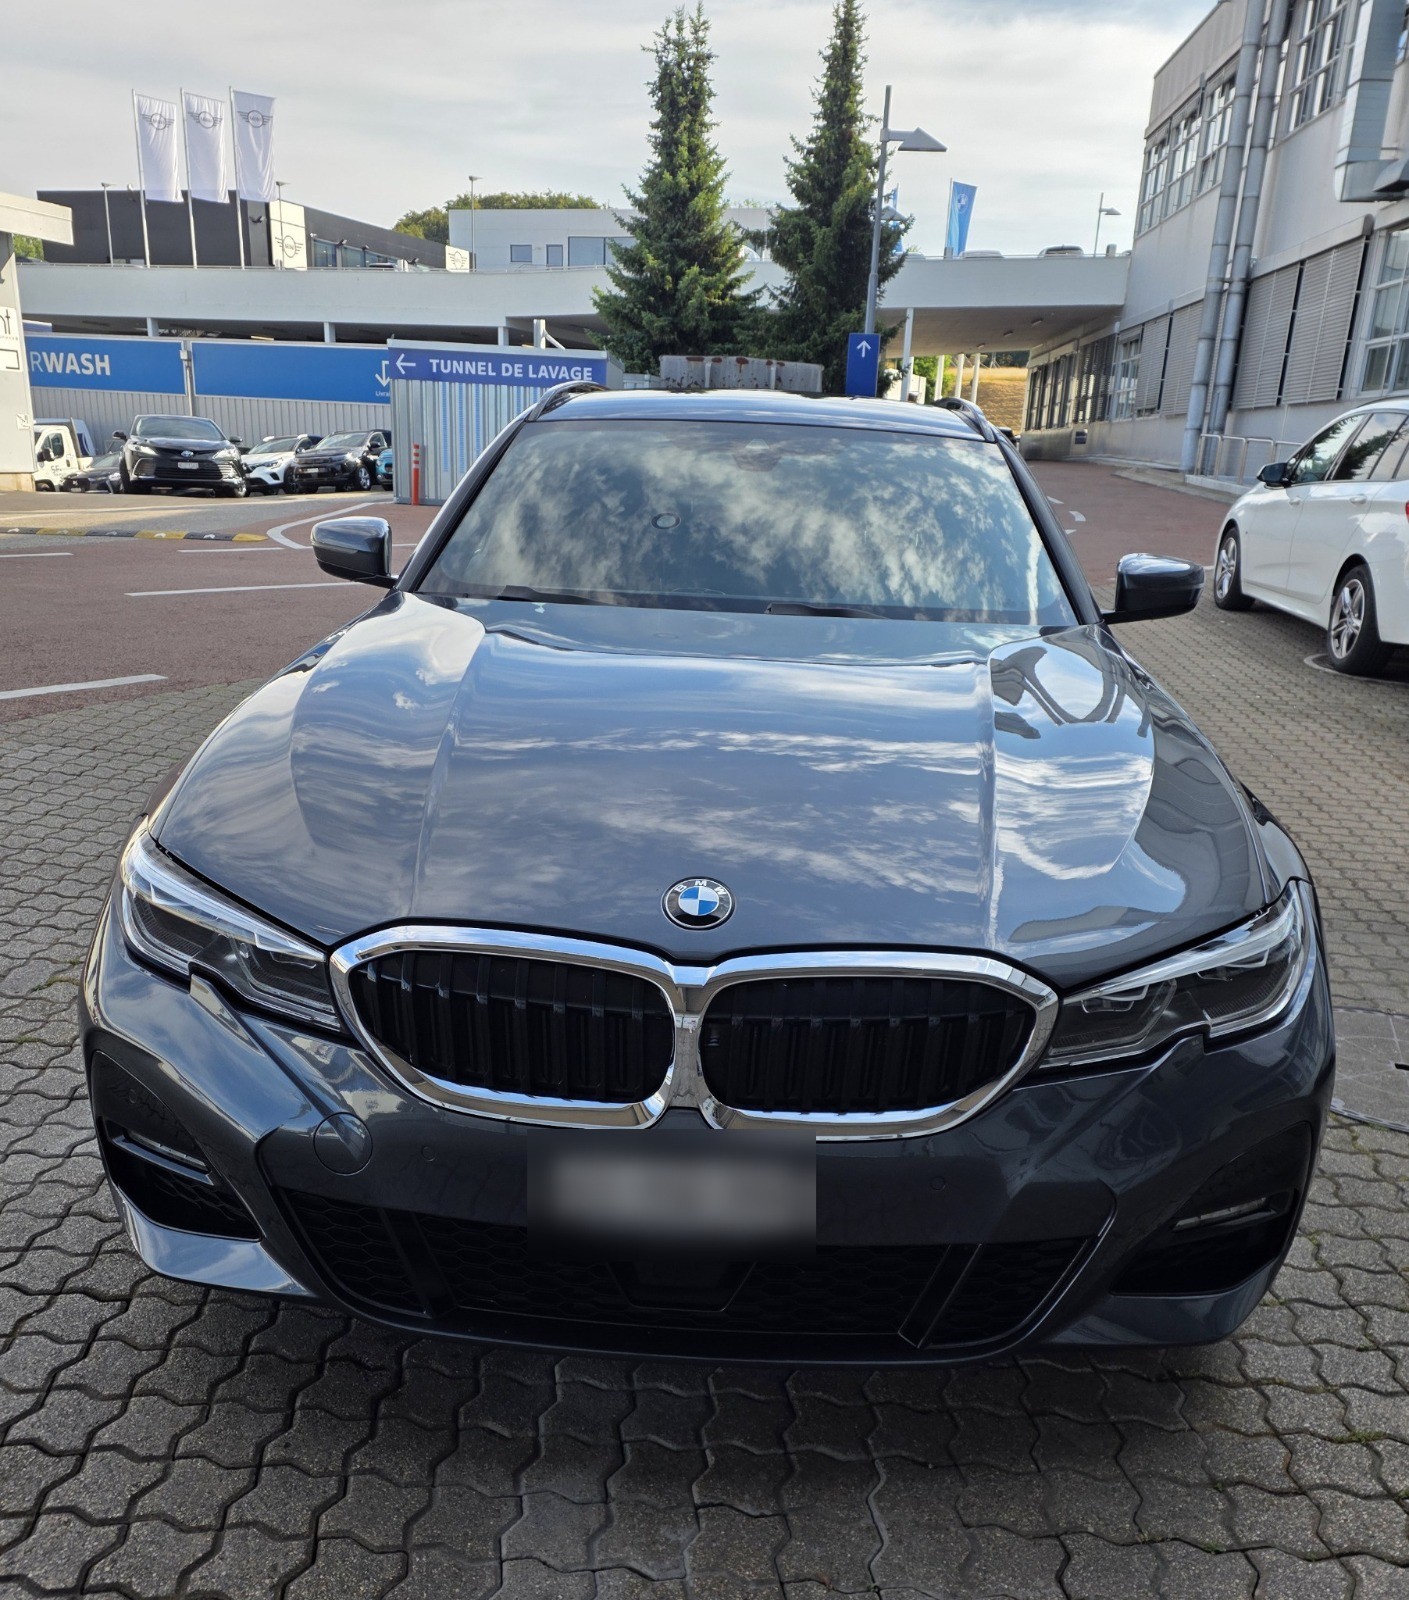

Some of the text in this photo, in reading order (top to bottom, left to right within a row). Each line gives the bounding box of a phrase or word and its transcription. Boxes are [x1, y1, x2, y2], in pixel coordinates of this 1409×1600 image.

[429, 358, 593, 381] TUNNEL DE LAVAGE
[674, 880, 727, 895] BMW
